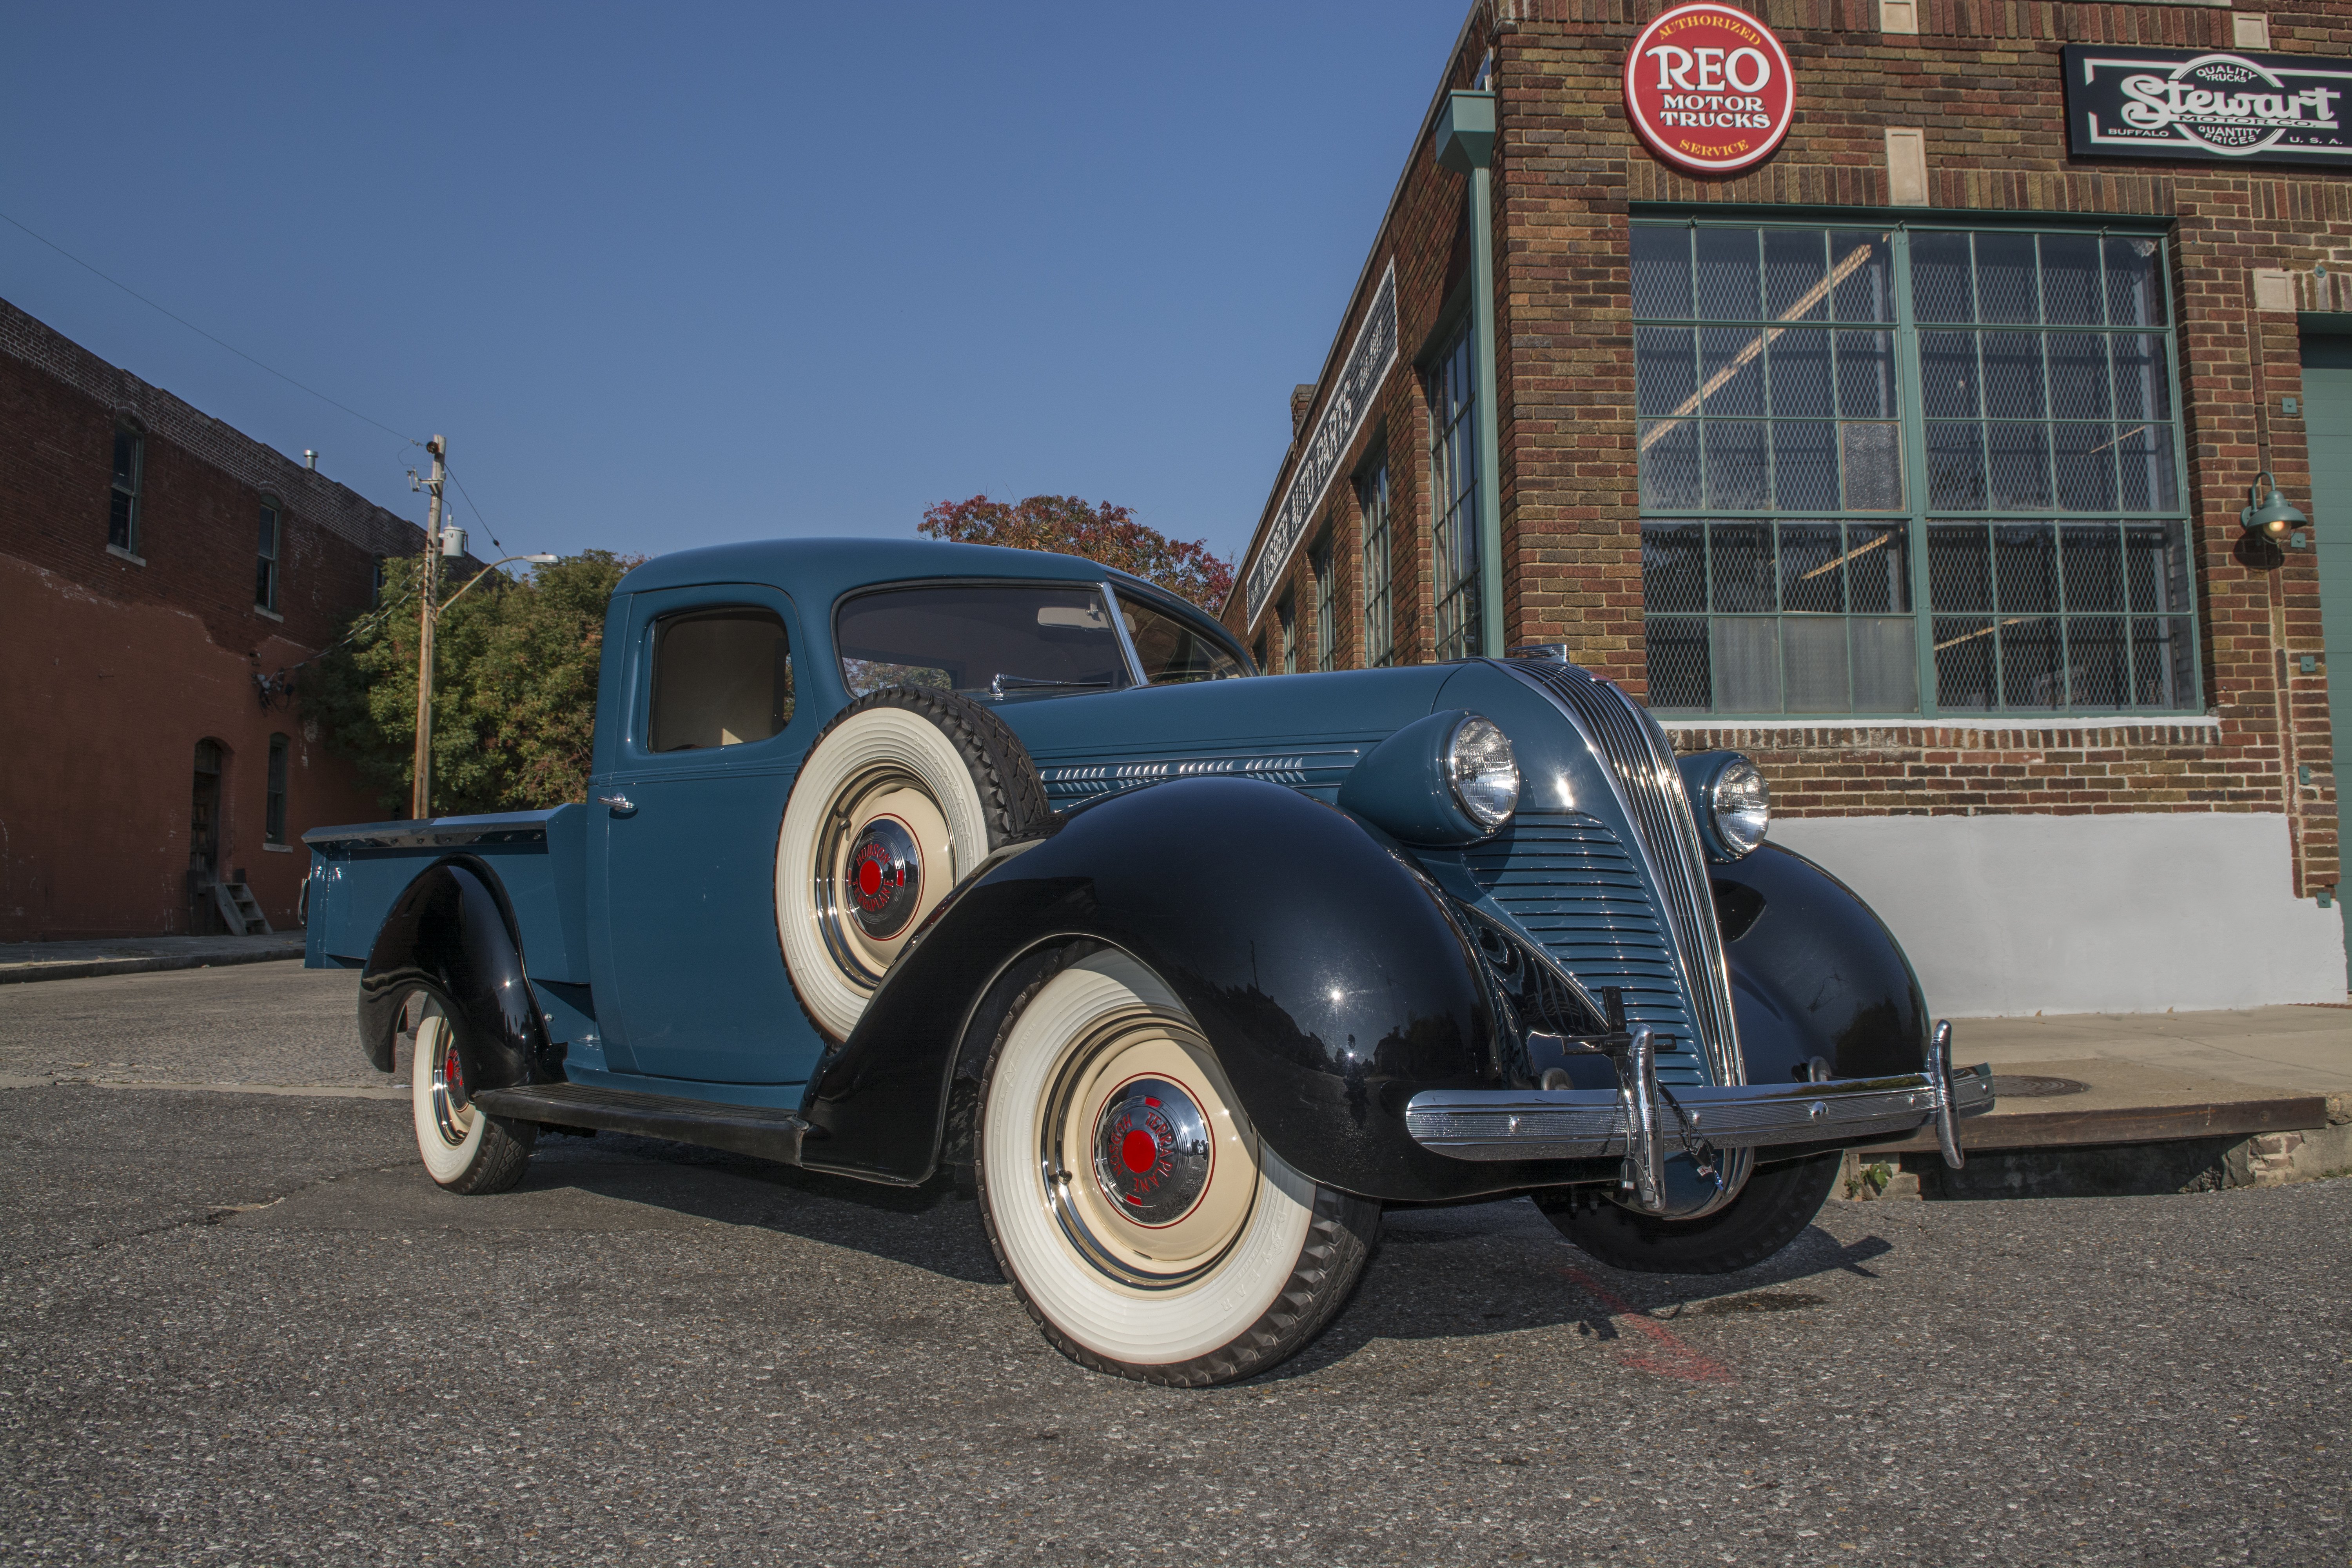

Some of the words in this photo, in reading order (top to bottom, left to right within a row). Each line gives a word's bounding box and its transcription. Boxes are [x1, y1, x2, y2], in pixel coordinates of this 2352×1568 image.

[1659, 15, 1760, 45] AUTHORIZED
[1646, 45, 1770, 93] REO
[2196, 65, 2258, 80] QUALITY
[2205, 74, 2247, 83] TRUCKS
[1663, 94, 1765, 111] MOTOR
[2120, 74, 2340, 130] Stewart
[1660, 111, 1771, 129] TRUCKS
[2179, 116, 2269, 125] MOTOR
[2108, 128, 2170, 137] BUFFALO
[2198, 125, 2262, 137] QUANTITY
[2204, 132, 2256, 145] PRICES
[1679, 140, 1749, 157] SERVICE
[1263, 512, 1289, 591] KISBER
[1291, 460, 1314, 537] AUTO
[1317, 379, 1352, 486] PARTS
[856, 843, 891, 867] HUDSON
[852, 878, 894, 912] TERRAPLANE
[1109, 1114, 1132, 1177] HUDSON
[1134, 1111, 1173, 1192] TERRAPLANE
